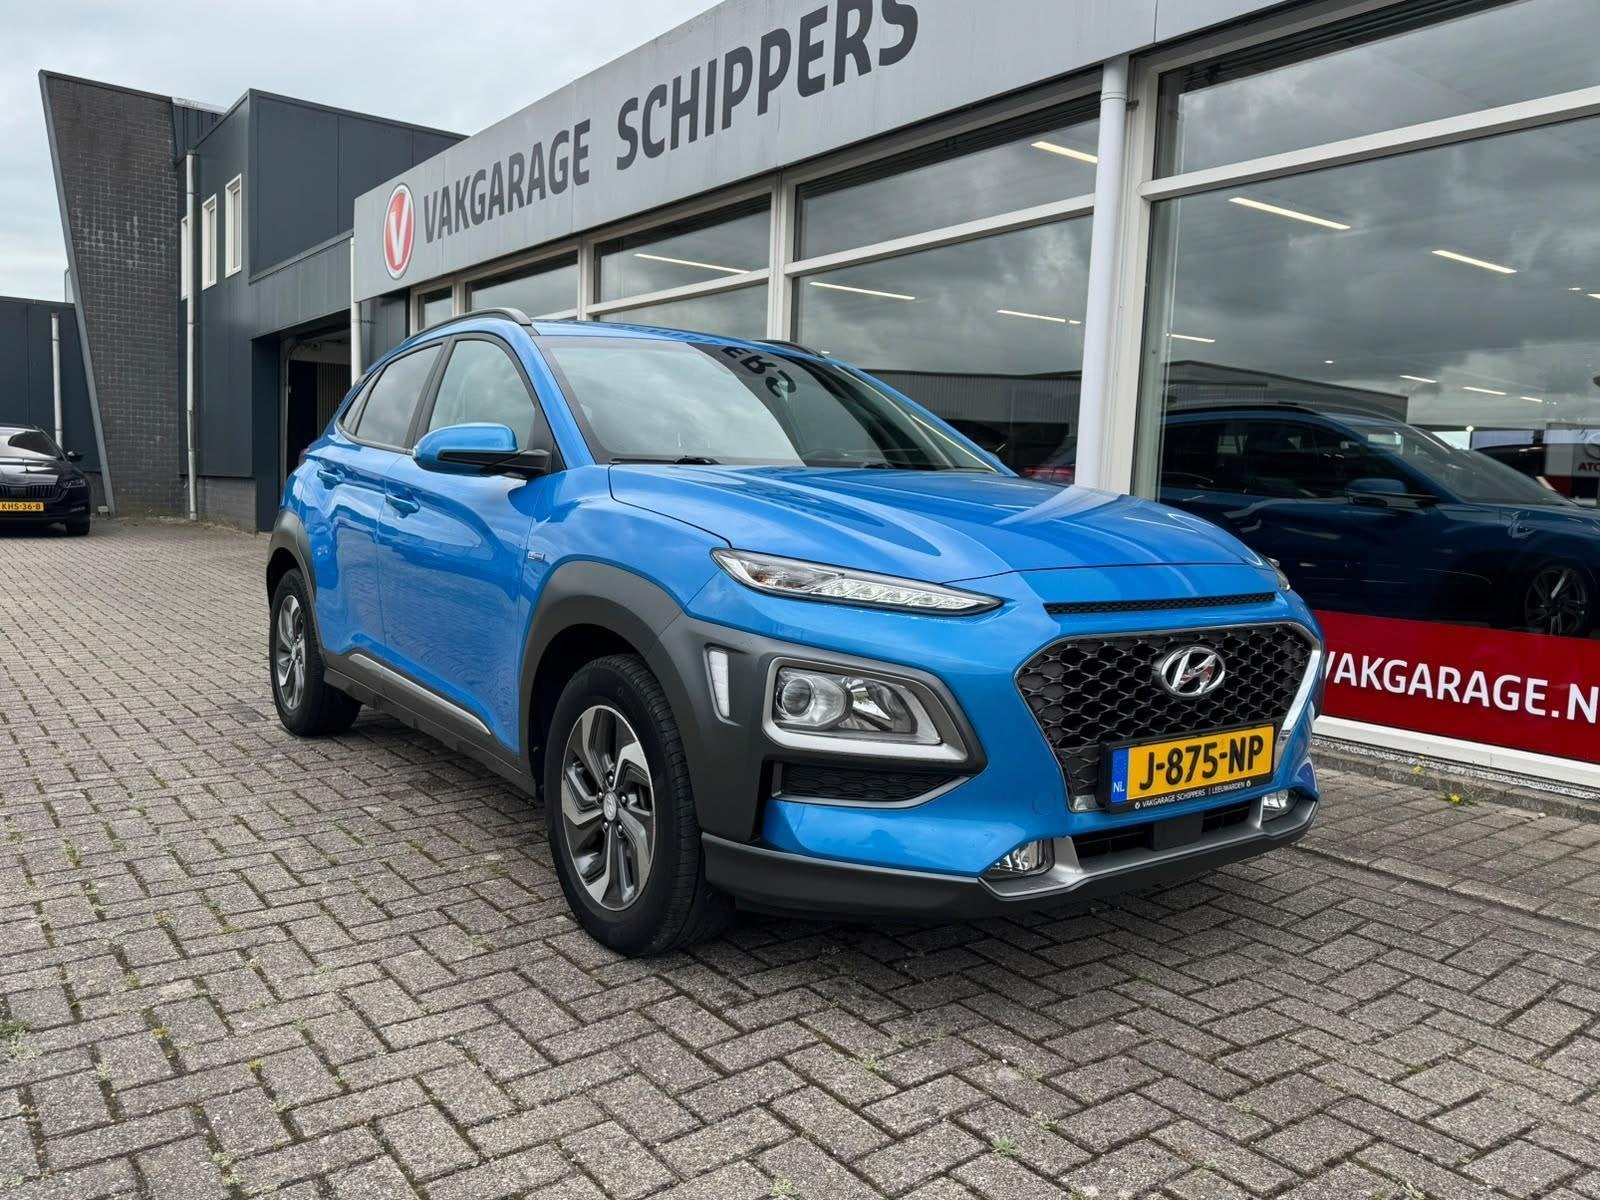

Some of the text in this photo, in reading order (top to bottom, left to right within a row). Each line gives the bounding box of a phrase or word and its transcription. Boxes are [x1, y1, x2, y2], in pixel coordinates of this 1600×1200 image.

[423, 0, 919, 244] VAKGARAGE SCHIPPERS
[1139, 735, 1264, 791] J-875-NP
[1113, 781, 1125, 793] NL
[1142, 781, 1245, 808] VAKGARAGE SCHIPPERS LEEUWARDEN
